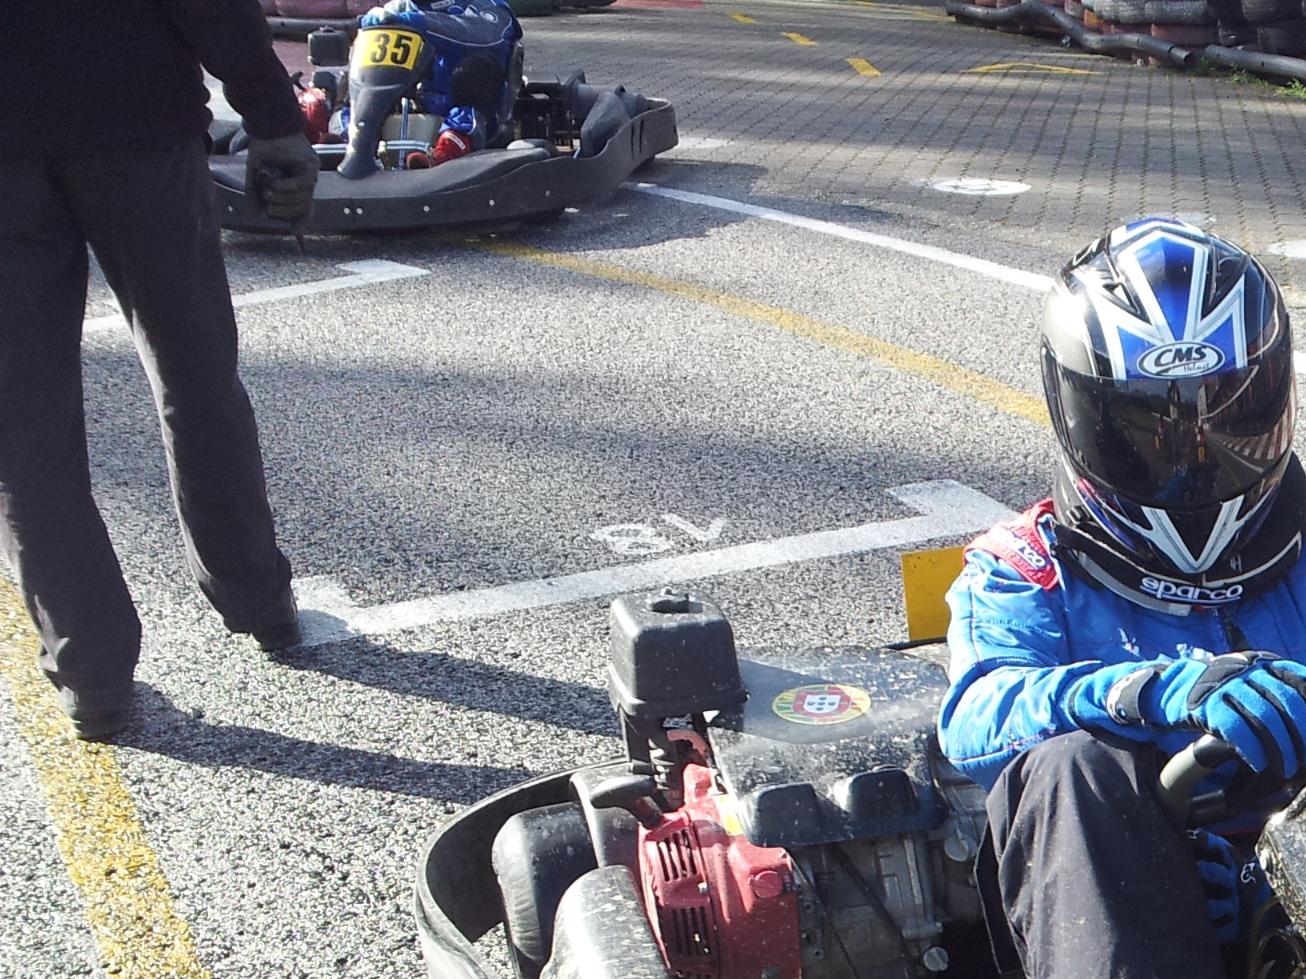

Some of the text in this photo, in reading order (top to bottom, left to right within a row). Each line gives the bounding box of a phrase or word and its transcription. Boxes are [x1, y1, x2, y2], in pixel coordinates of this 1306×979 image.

[369, 33, 413, 65] 35
[1154, 346, 1208, 367] CMS
[1001, 526, 1046, 568] arco
[1140, 576, 1243, 604] sparco
